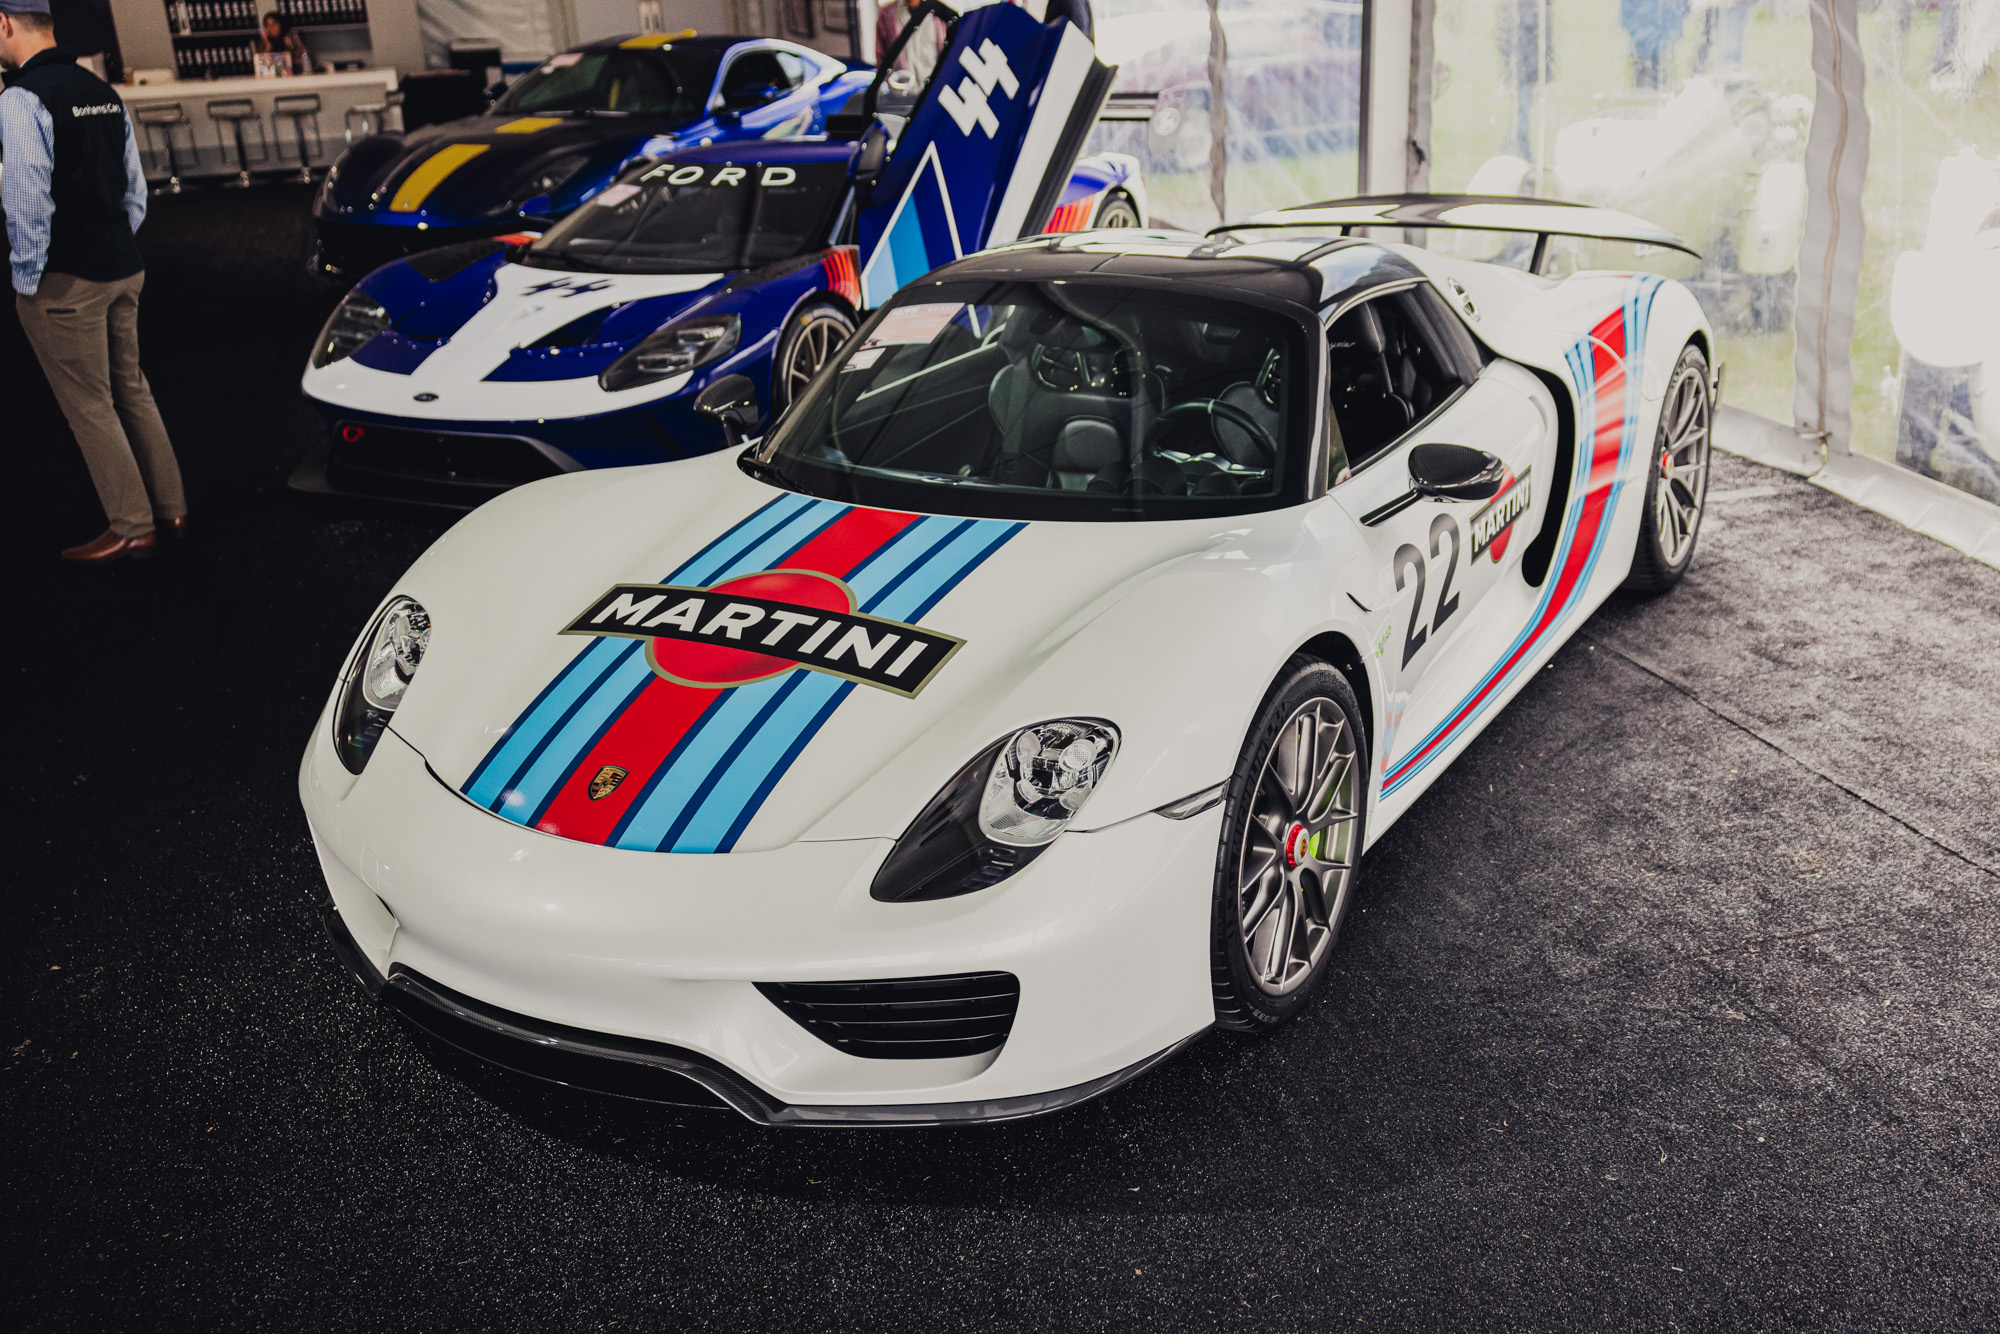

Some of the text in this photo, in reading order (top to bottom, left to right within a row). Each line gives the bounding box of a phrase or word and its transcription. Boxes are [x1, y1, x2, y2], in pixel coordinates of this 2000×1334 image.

[937, 37, 1020, 139] 44
[640, 164, 796, 186] FORD
[1473, 479, 1530, 553] MARTINI
[590, 593, 928, 678] MARTINI
[1393, 513, 1461, 673] 22
